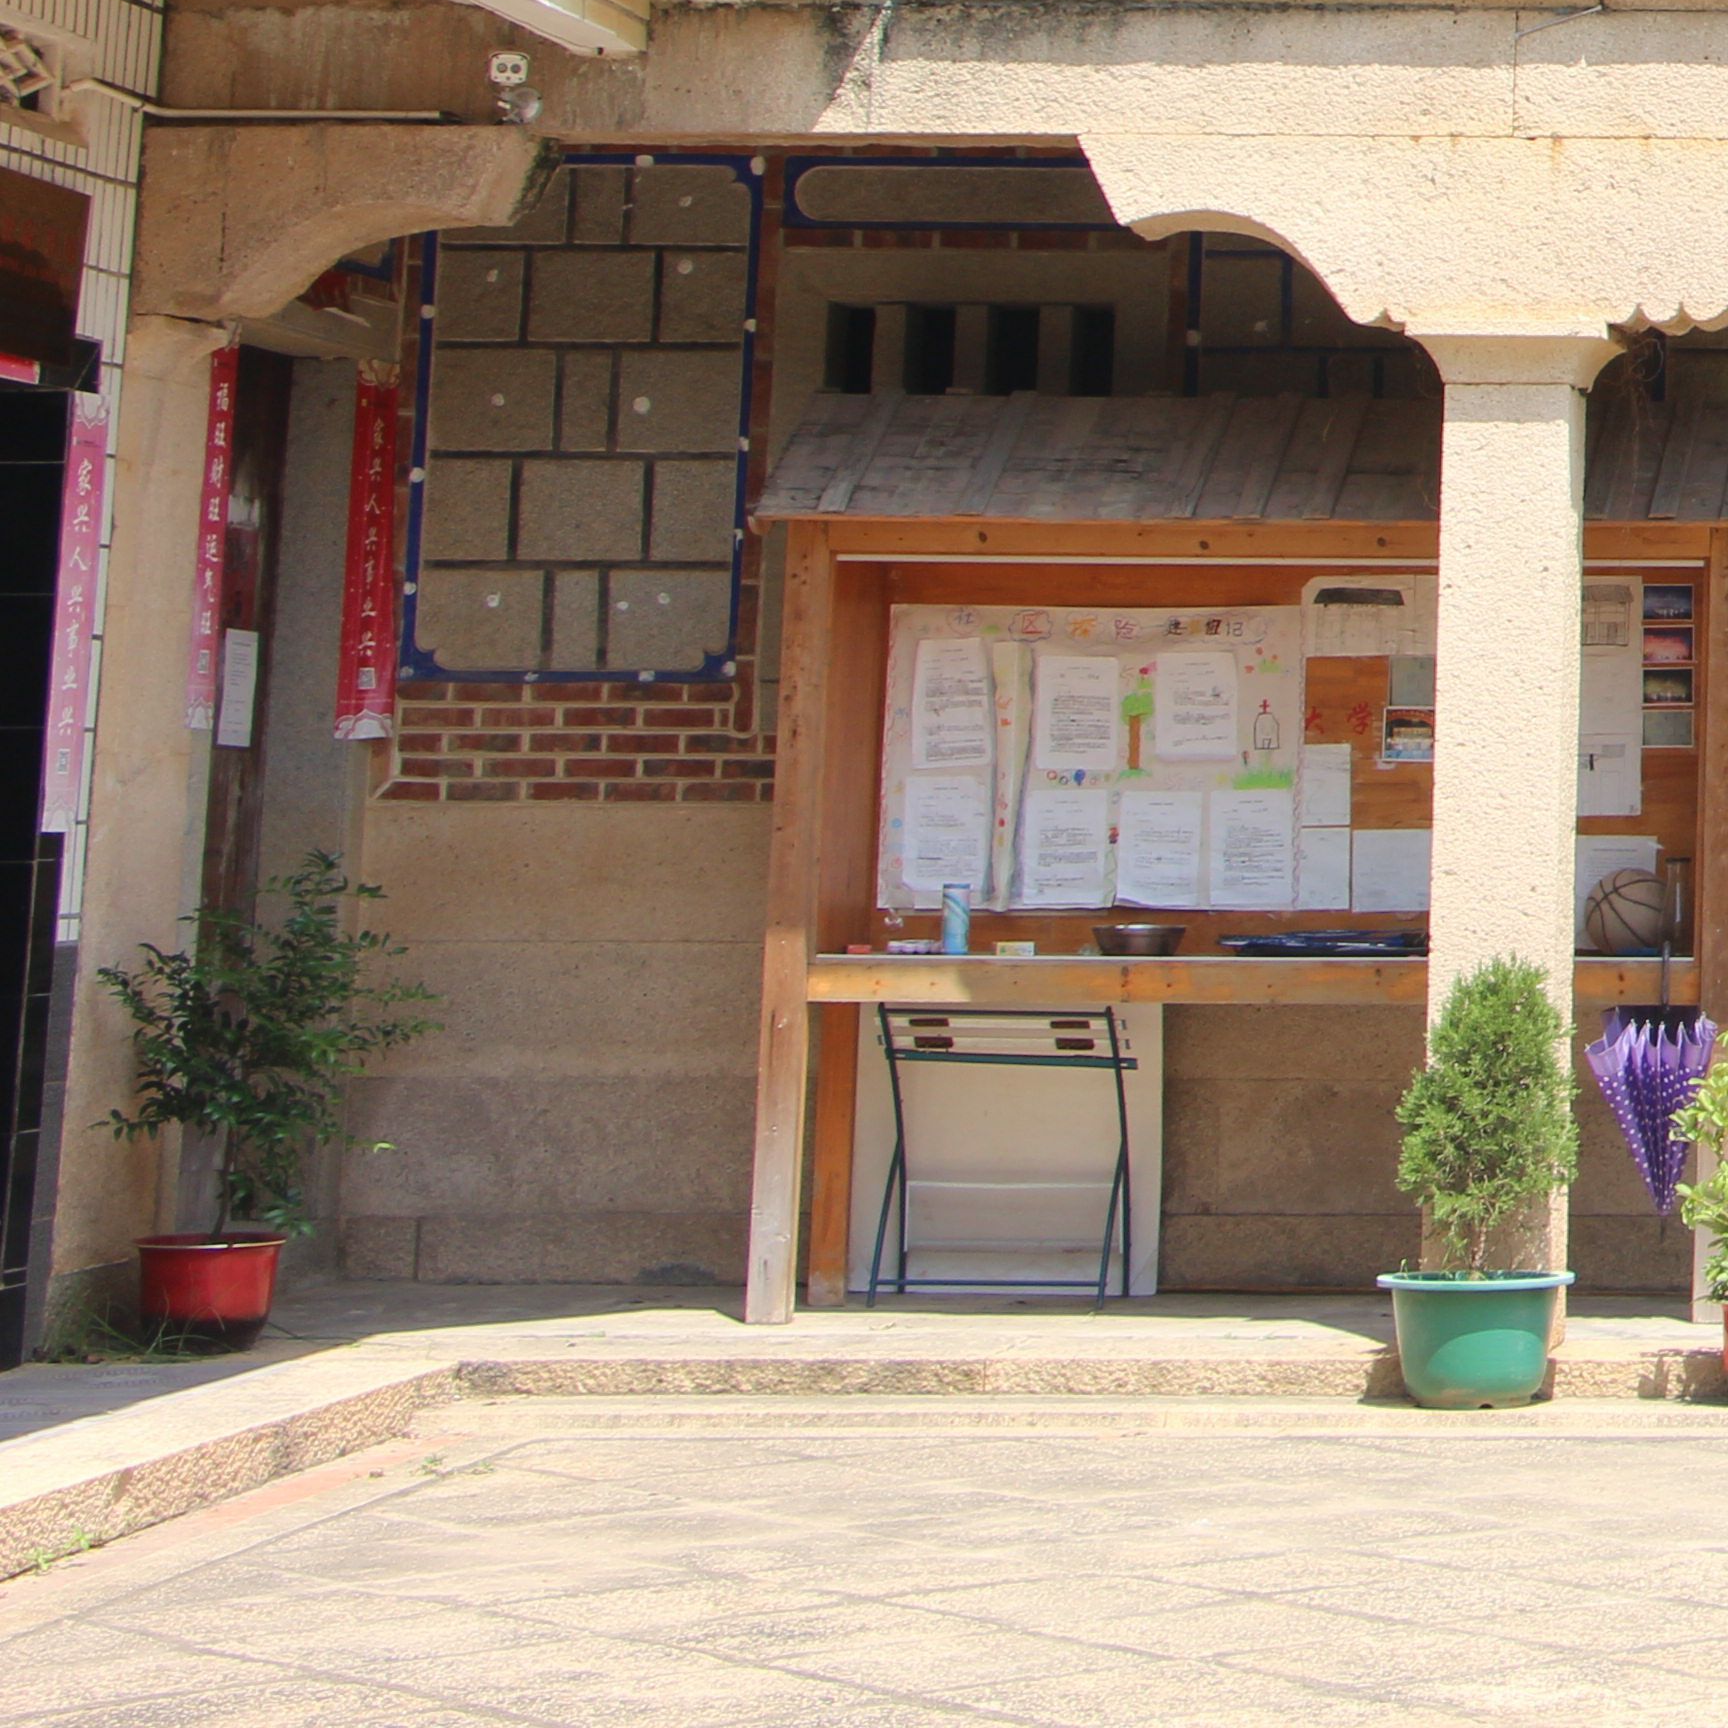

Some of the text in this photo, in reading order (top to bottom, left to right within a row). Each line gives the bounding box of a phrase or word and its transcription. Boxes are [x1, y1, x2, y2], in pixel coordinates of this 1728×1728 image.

[57, 458, 93, 736] 家兴人兴事业兴
[202, 381, 229, 635] 福旺财旺运气旺
[357, 417, 385, 657] 家兴人兴事业兴
